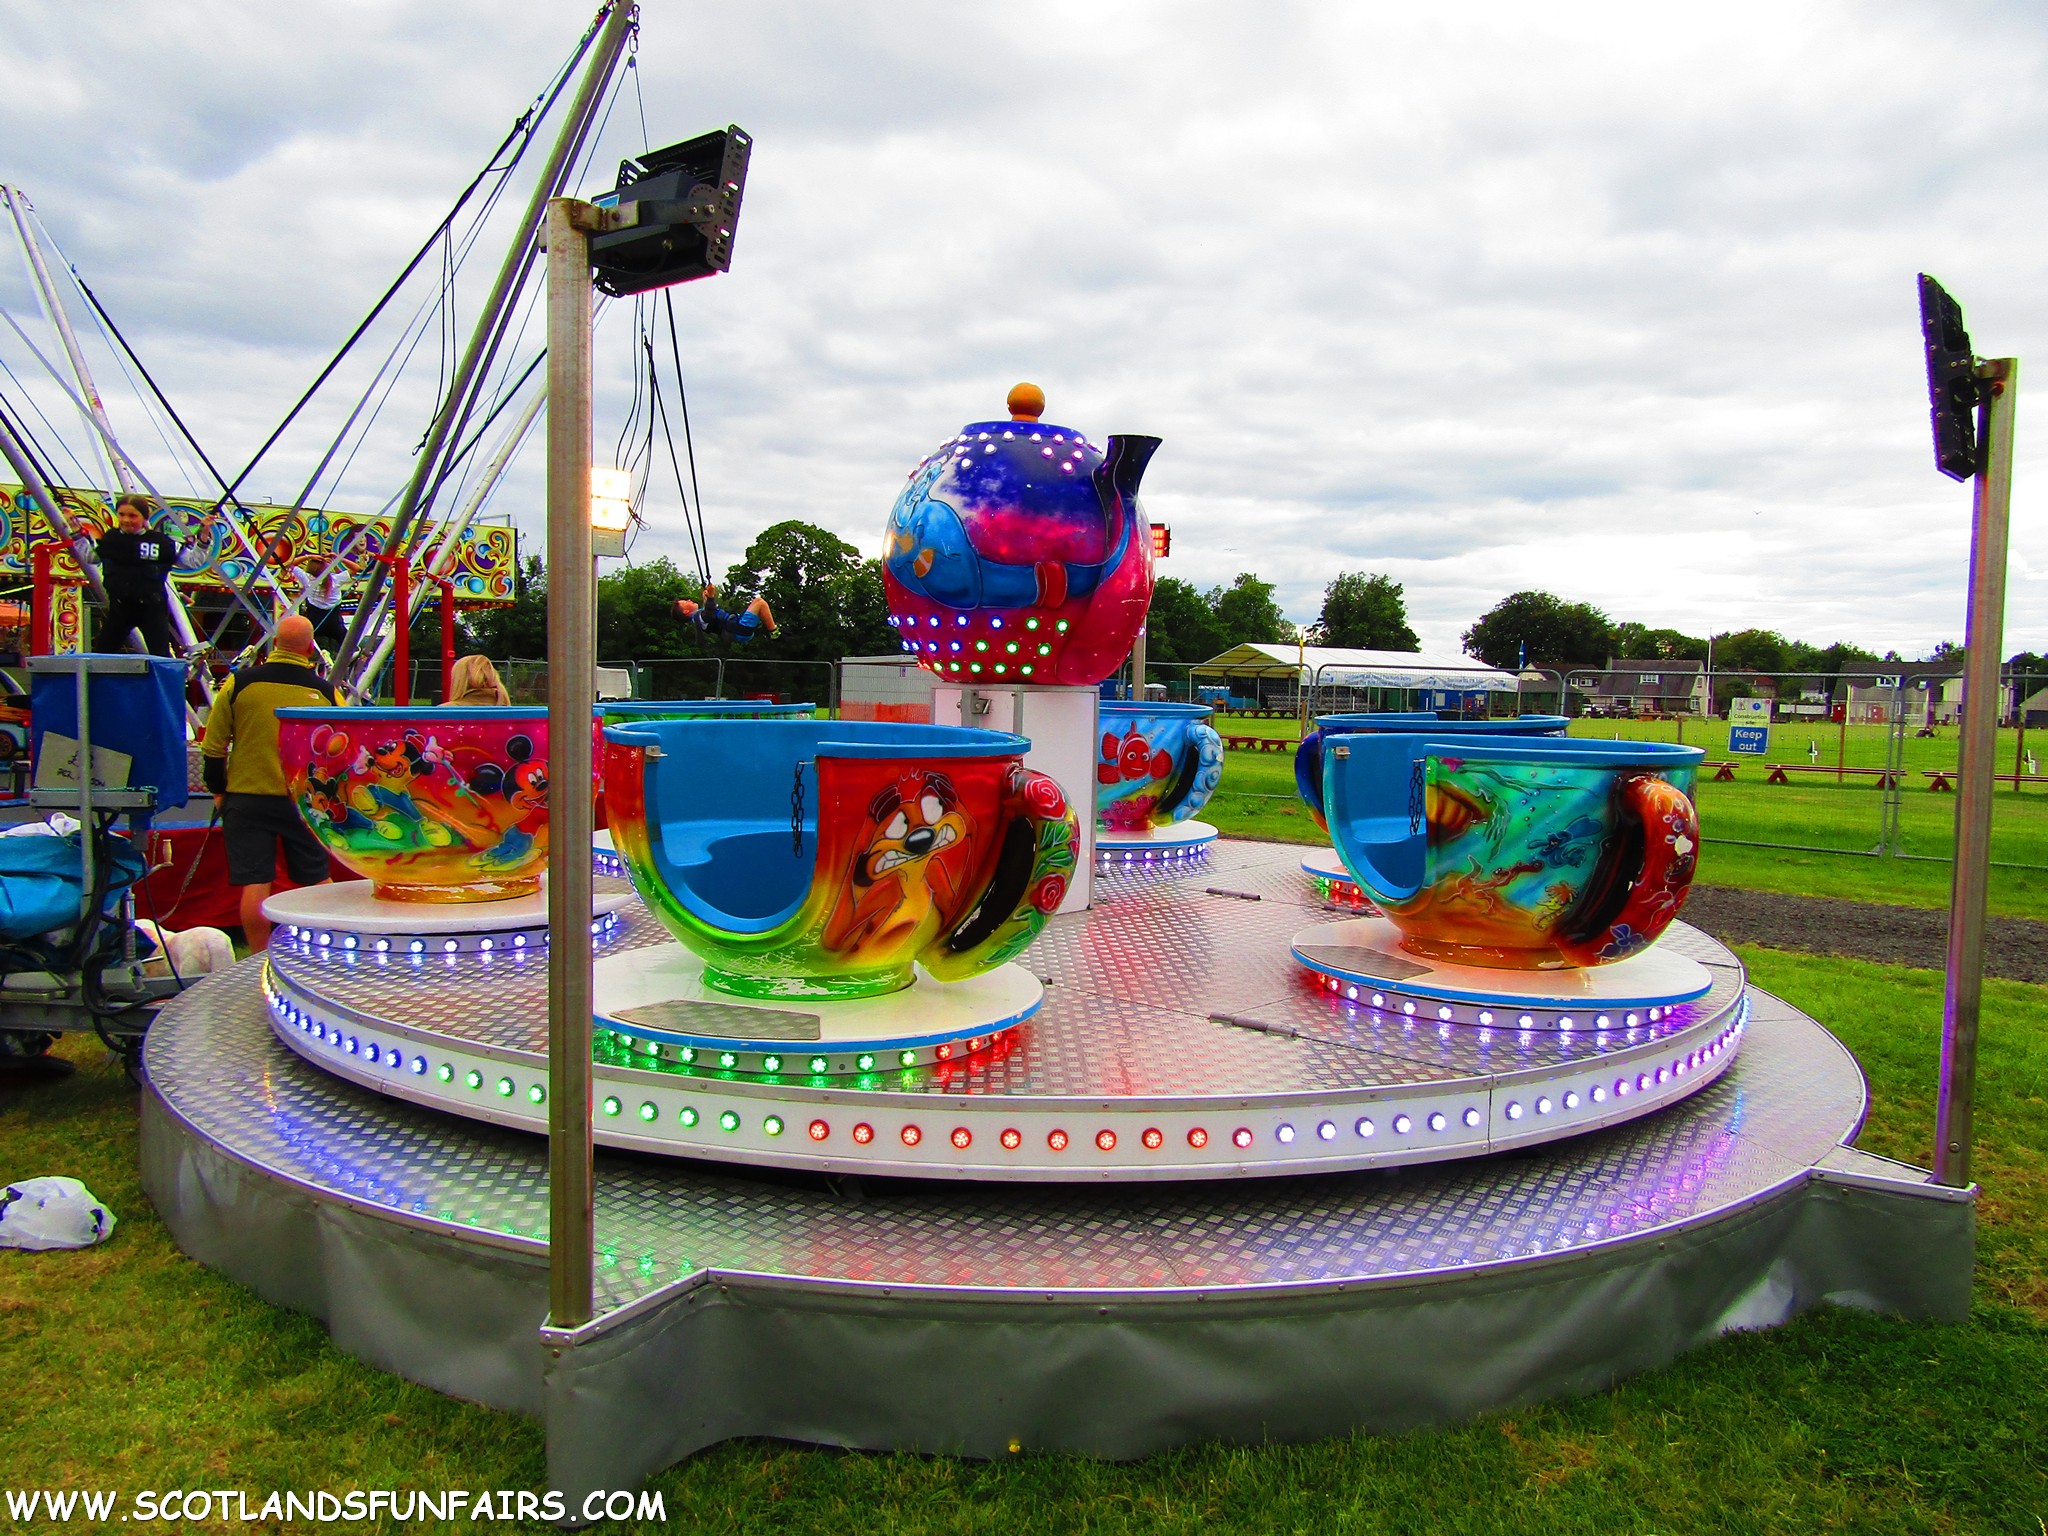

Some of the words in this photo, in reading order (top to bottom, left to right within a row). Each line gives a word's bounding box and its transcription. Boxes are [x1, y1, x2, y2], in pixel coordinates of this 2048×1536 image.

[140, 542, 160, 560] 96
[1735, 729, 1763, 741] Keep
[1738, 742, 1757, 751] out
